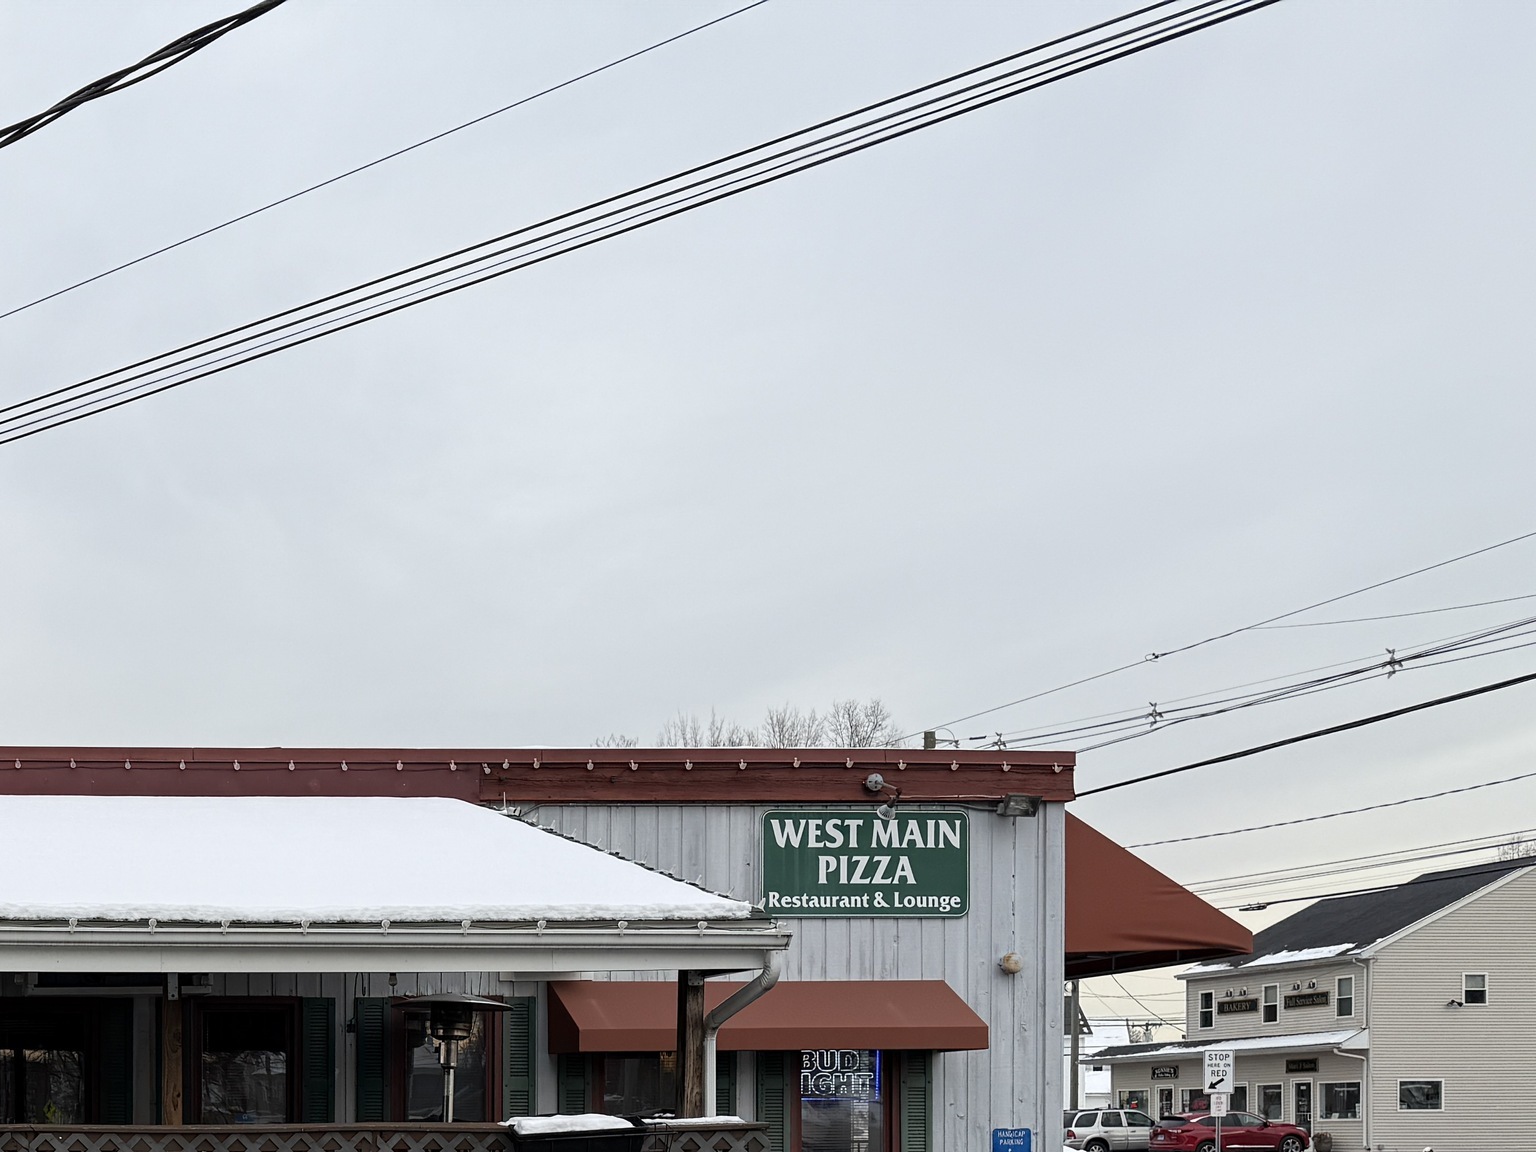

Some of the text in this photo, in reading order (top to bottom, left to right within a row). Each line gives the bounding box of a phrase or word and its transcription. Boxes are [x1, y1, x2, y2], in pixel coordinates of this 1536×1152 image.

[770, 819, 962, 849] WEST MAIN
[818, 855, 917, 885] PIZZA
[768, 891, 961, 911] Restaurant & Lounge
[1224, 1002, 1251, 1012] BAKERY
[1285, 997, 1296, 1007] Full
[1296, 997, 1313, 1006] Service
[801, 1050, 859, 1072] BUD
[1208, 1053, 1230, 1061] STOP
[1211, 1069, 1227, 1077] RED
[801, 1072, 874, 1095] IGHT
